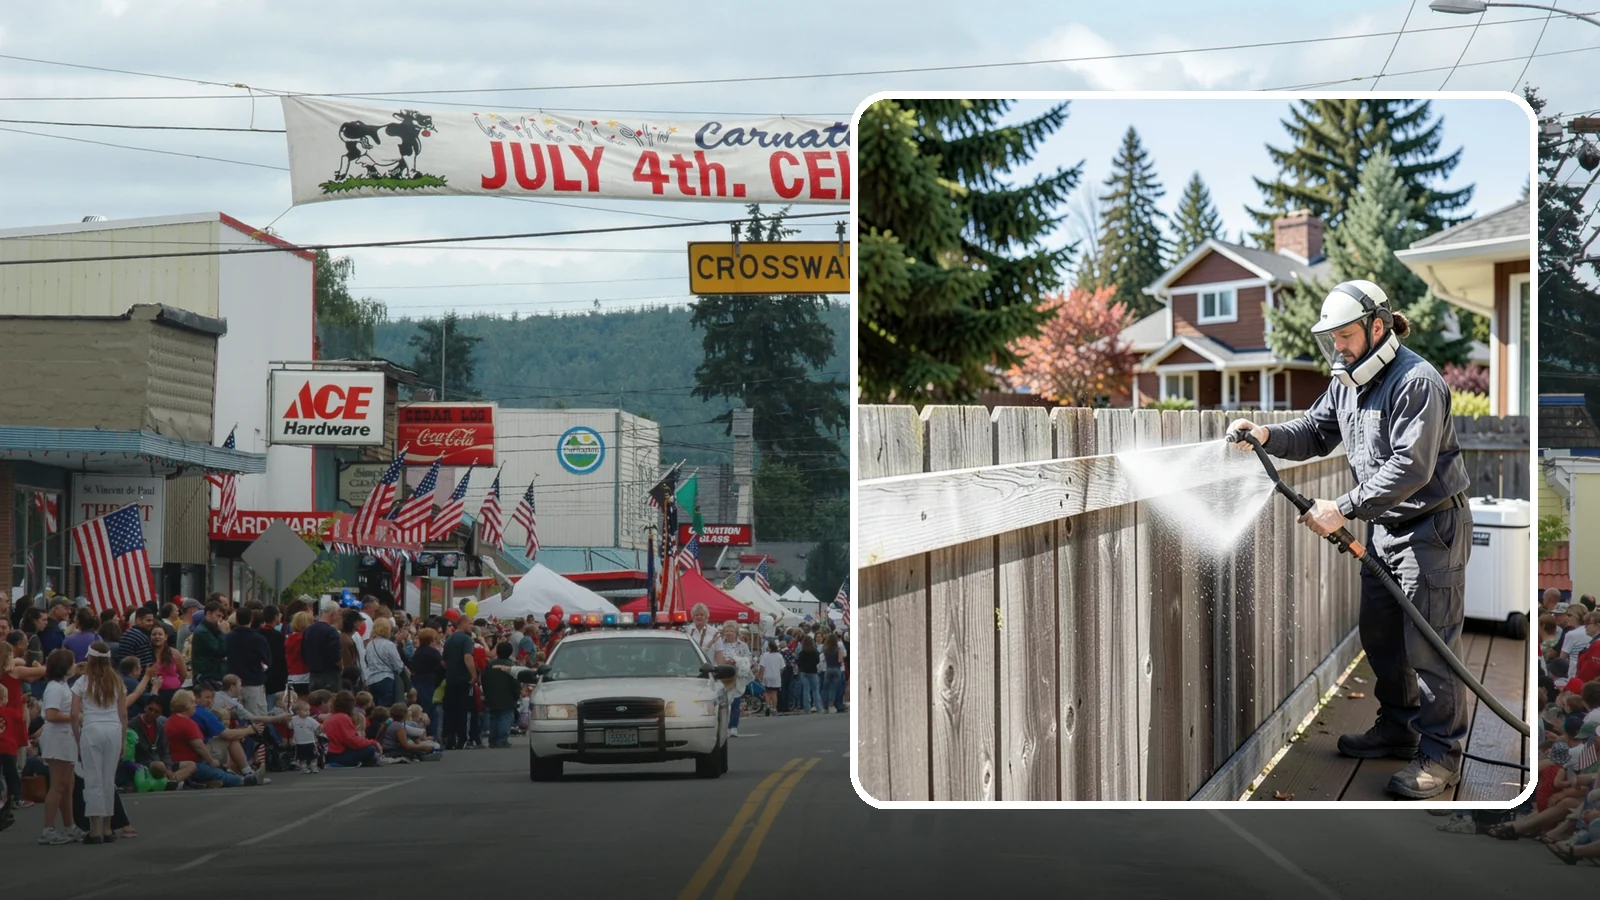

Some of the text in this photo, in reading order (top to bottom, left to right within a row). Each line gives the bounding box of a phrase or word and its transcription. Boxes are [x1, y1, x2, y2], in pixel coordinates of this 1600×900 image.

[695, 121, 850, 150] Carnat
[481, 141, 605, 193] JULY
[632, 150, 747, 198] 4th.
[697, 254, 850, 280] CROSSWA
[283, 380, 374, 420] ACE
[405, 409, 485, 422] CEDAR LOG
[284, 421, 371, 437] Hardware
[416, 428, 477, 447] Coca-Cola
[95, 485, 124, 495] Vincent
[126, 486, 136, 495] de
[138, 486, 155, 495] Paul
[688, 526, 742, 535] CRNATION
[699, 535, 730, 543] GLASS
